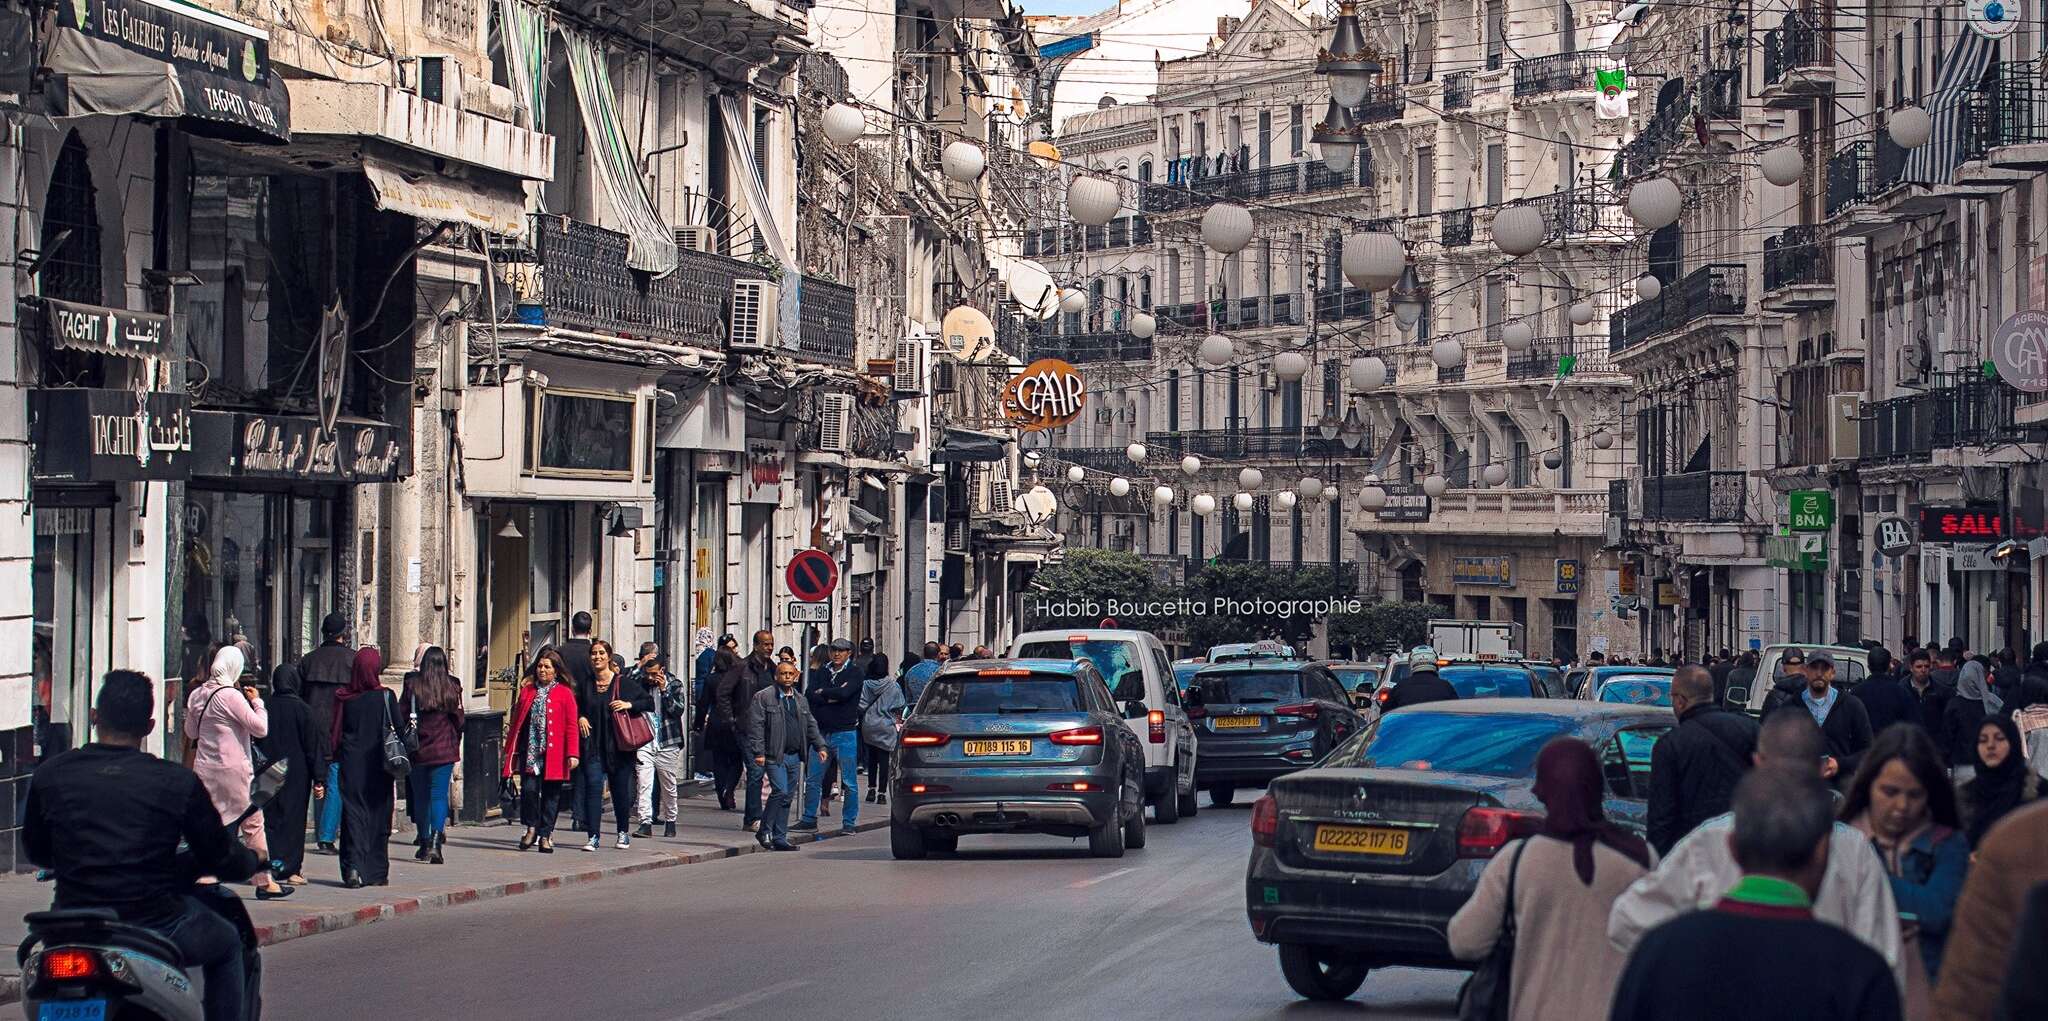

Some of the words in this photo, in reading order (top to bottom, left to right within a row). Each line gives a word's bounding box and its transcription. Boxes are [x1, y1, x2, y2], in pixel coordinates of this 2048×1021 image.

[102, 1, 119, 37] LES
[121, 8, 165, 53] GALERIES
[205, 87, 248, 117] TAGHIT
[248, 100, 278, 129] CUIR
[58, 310, 100, 341] TAGHIT
[2019, 378, 2048, 387] 718
[92, 414, 136, 455] TAGHIT
[1795, 514, 1825, 527] BNA
[1881, 521, 1910, 548] BA
[1559, 583, 1577, 591] CPA
[792, 605, 807, 619] 07h
[814, 605, 828, 619] 19h
[967, 741, 998, 752] 077189
[1001, 741, 1015, 752] 115
[1018, 741, 1028, 752] 16
[1333, 809, 1382, 819] SYMBOL
[1319, 829, 1368, 847] 022232
[1369, 833, 1387, 848] 117
[1390, 834, 1404, 849] 16
